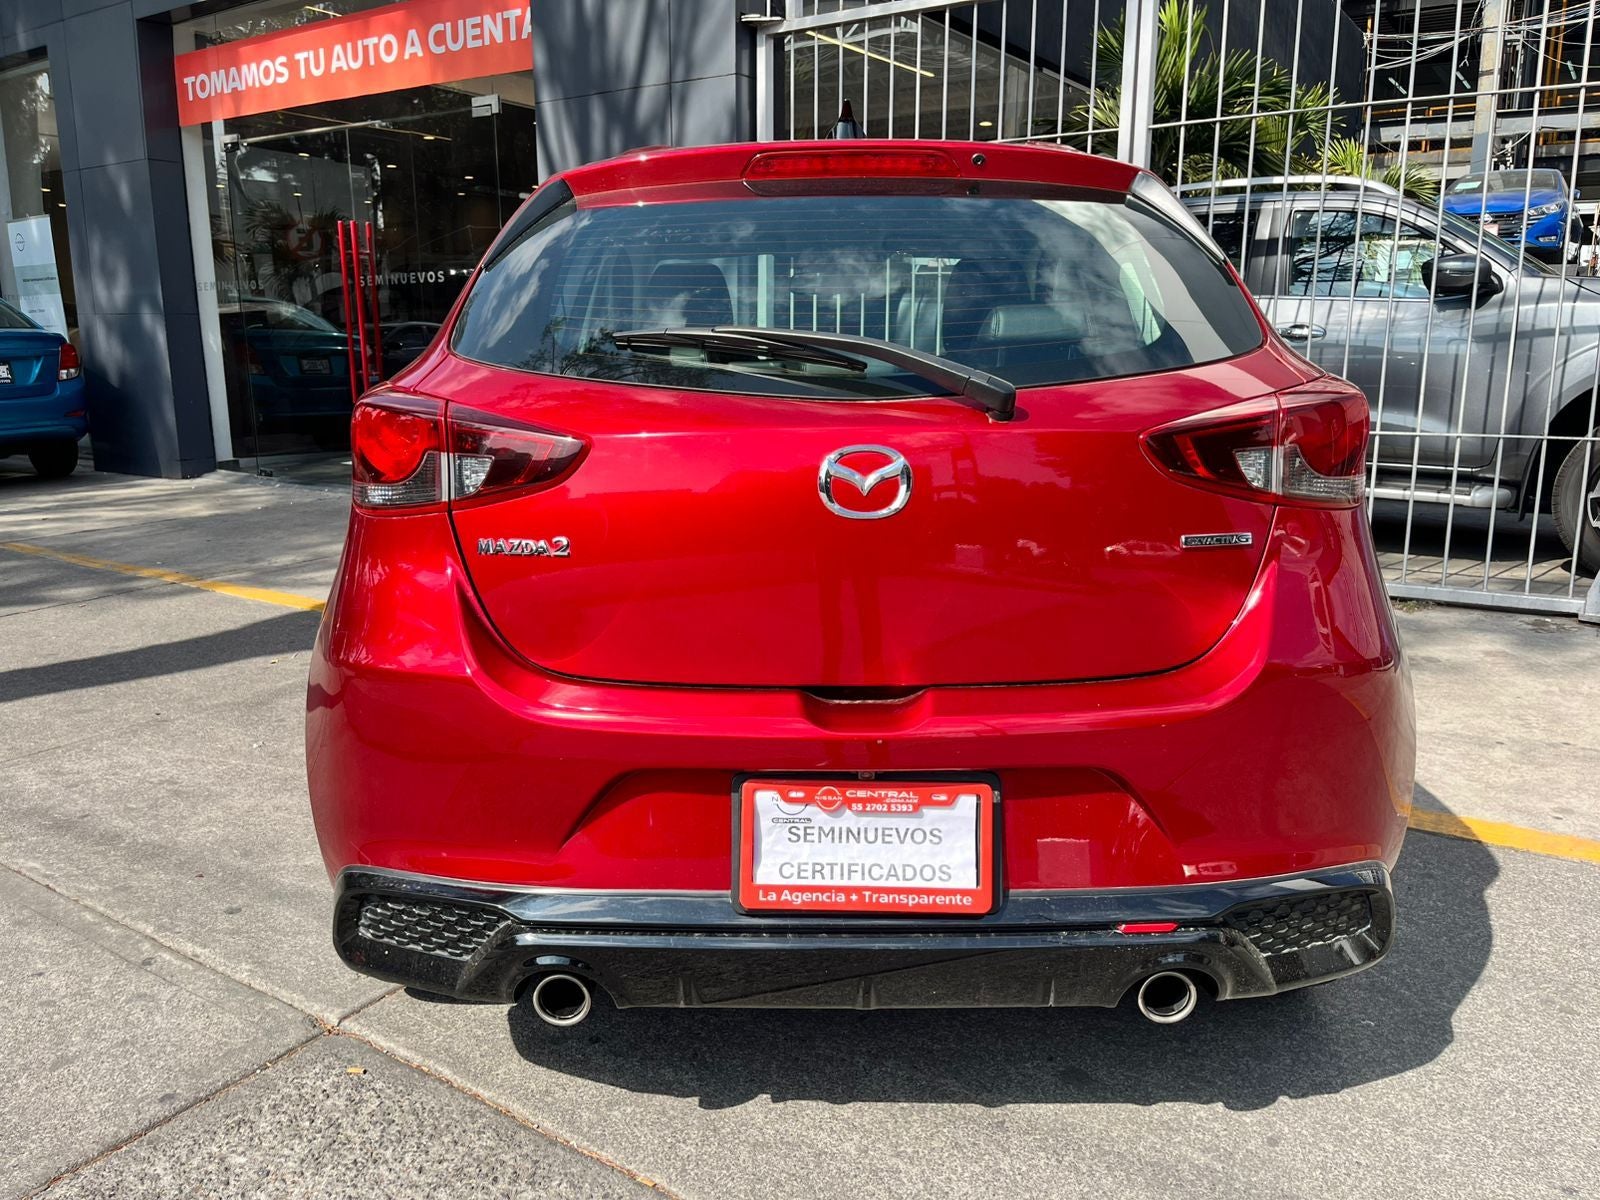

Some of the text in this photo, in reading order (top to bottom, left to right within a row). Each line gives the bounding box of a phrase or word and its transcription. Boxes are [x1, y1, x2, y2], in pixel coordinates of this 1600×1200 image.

[184, 56, 289, 101] TOMAMOS
[295, 48, 325, 79] TU
[331, 34, 398, 73] AUTO
[404, 29, 423, 60] A
[360, 270, 445, 287] SEMINUEVOS
[845, 790, 918, 799] CENTRAL
[851, 803, 913, 812] 55 2702 5393
[787, 826, 943, 845] SEMINUEVOS
[778, 862, 952, 882] CERTIFICADOS
[758, 889, 776, 902] La
[780, 890, 846, 905] Agencia
[862, 891, 973, 907] Transparente
